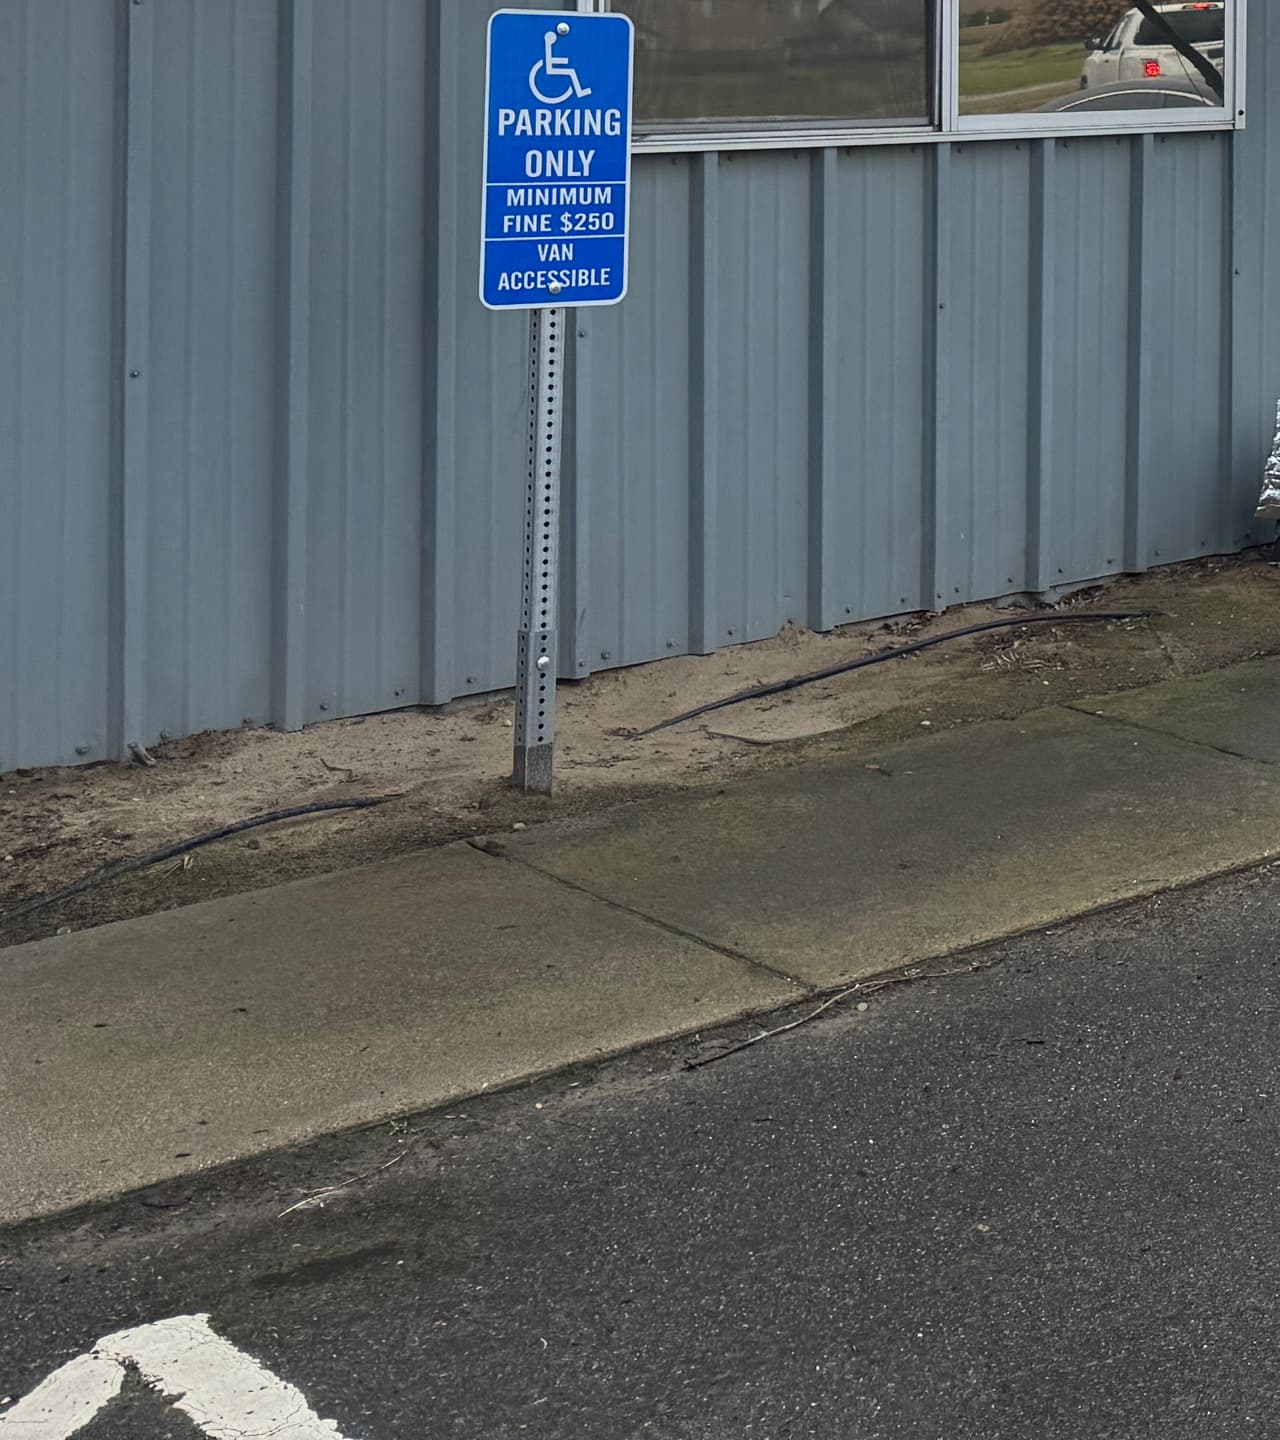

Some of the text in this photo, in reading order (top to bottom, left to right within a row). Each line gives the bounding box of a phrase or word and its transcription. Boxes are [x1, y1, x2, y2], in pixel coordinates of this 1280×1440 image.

[498, 108, 621, 136] PARKING
[525, 150, 596, 177] ONLY
[507, 187, 612, 207] MINIMUM
[503, 211, 615, 233] FINE $250
[537, 243, 574, 262] VAN
[497, 268, 611, 291] ACCESSIBLE
